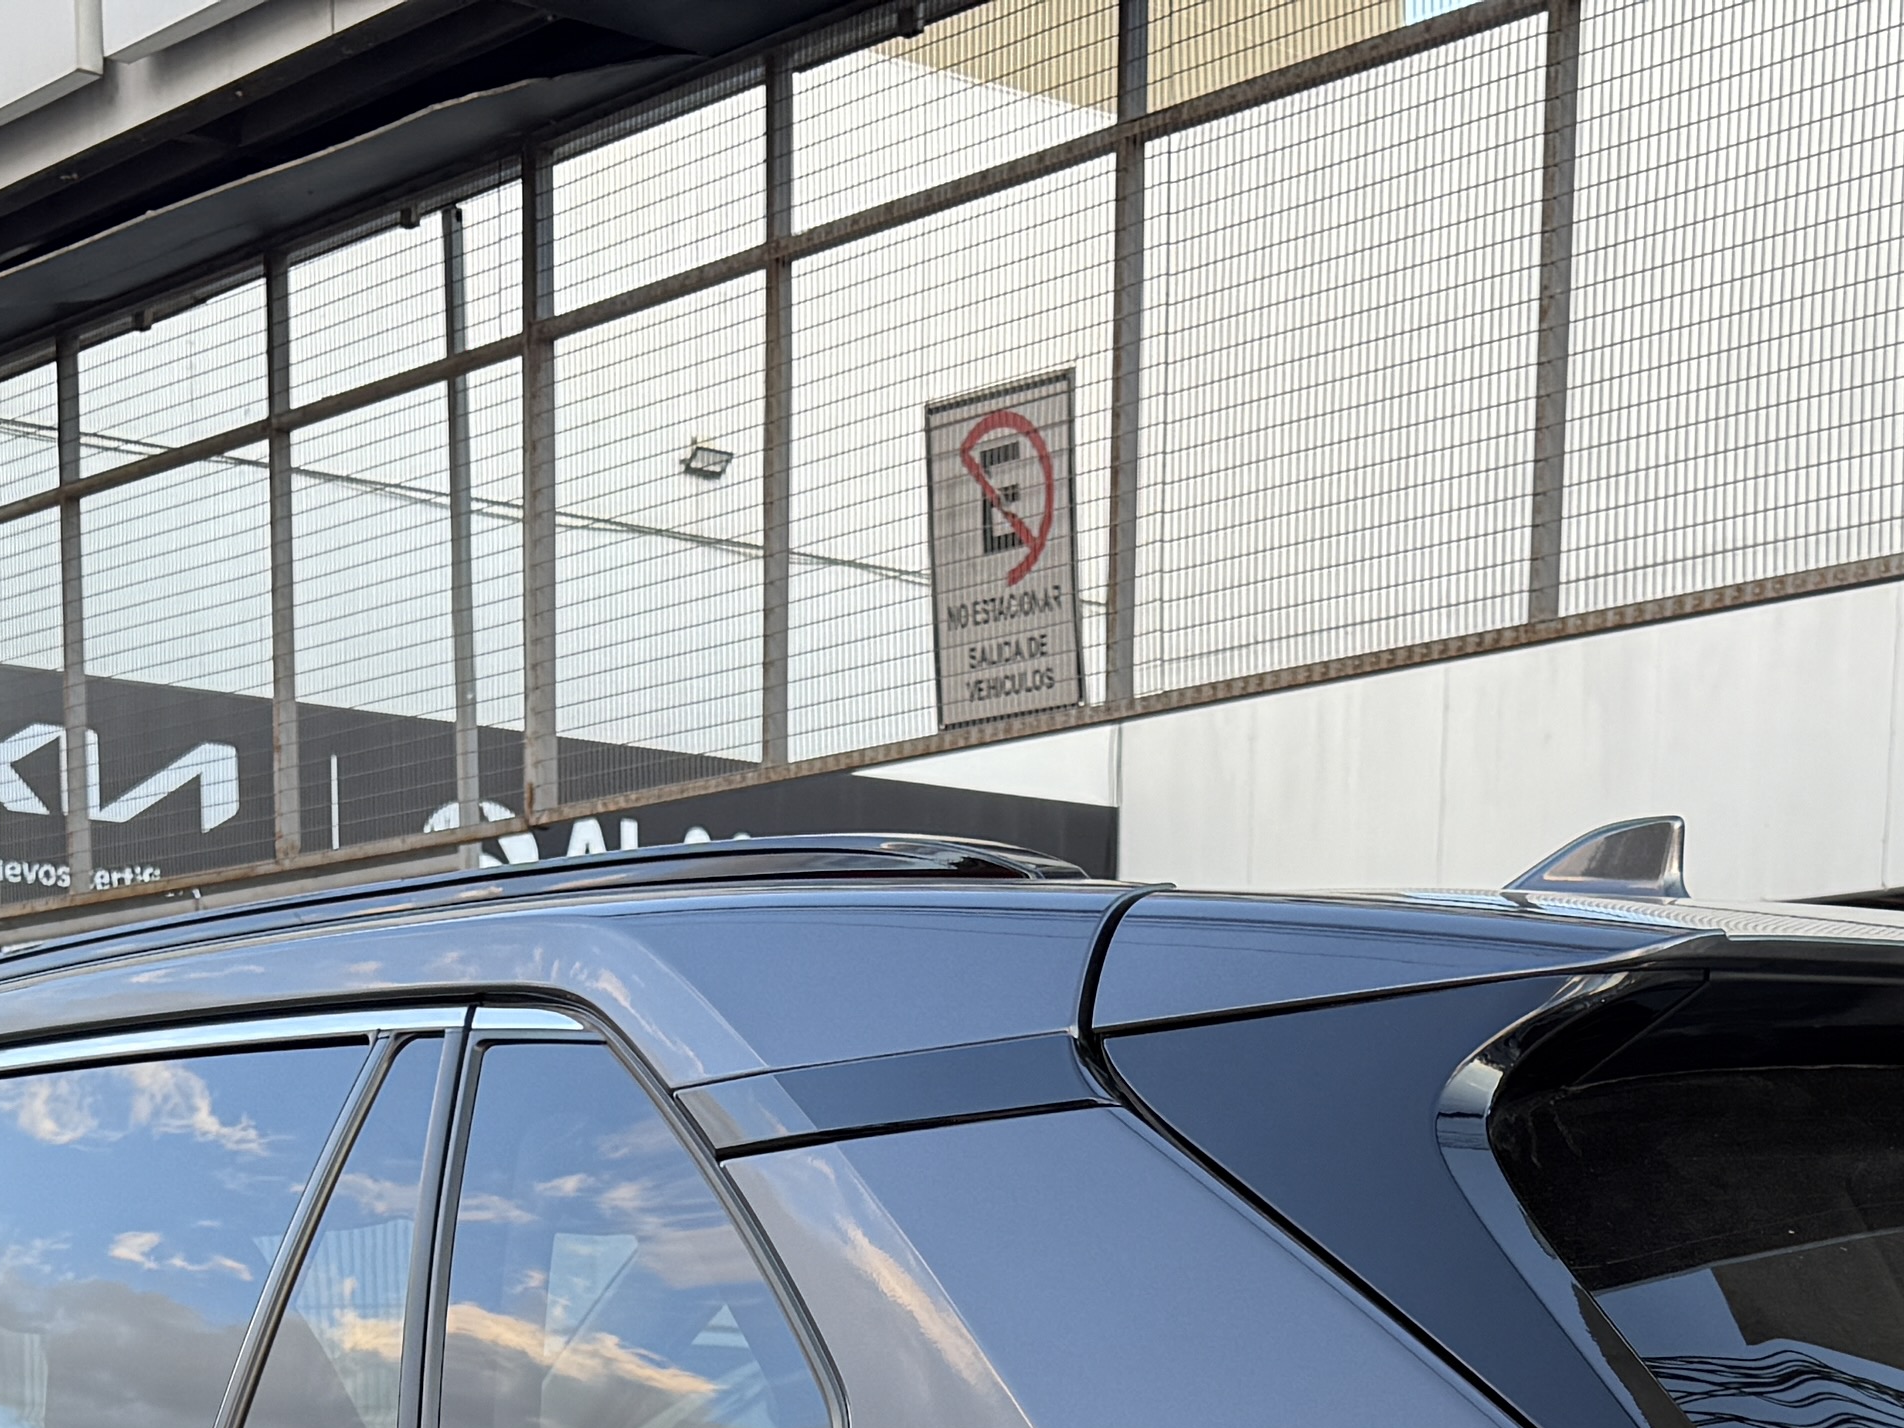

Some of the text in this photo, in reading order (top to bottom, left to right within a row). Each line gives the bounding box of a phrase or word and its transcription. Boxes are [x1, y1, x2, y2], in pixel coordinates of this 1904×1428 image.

[947, 585, 1062, 631] NO ESTACIONAR
[969, 634, 1048, 669] SALIDA DE
[966, 667, 1055, 702] VEHICULOS
